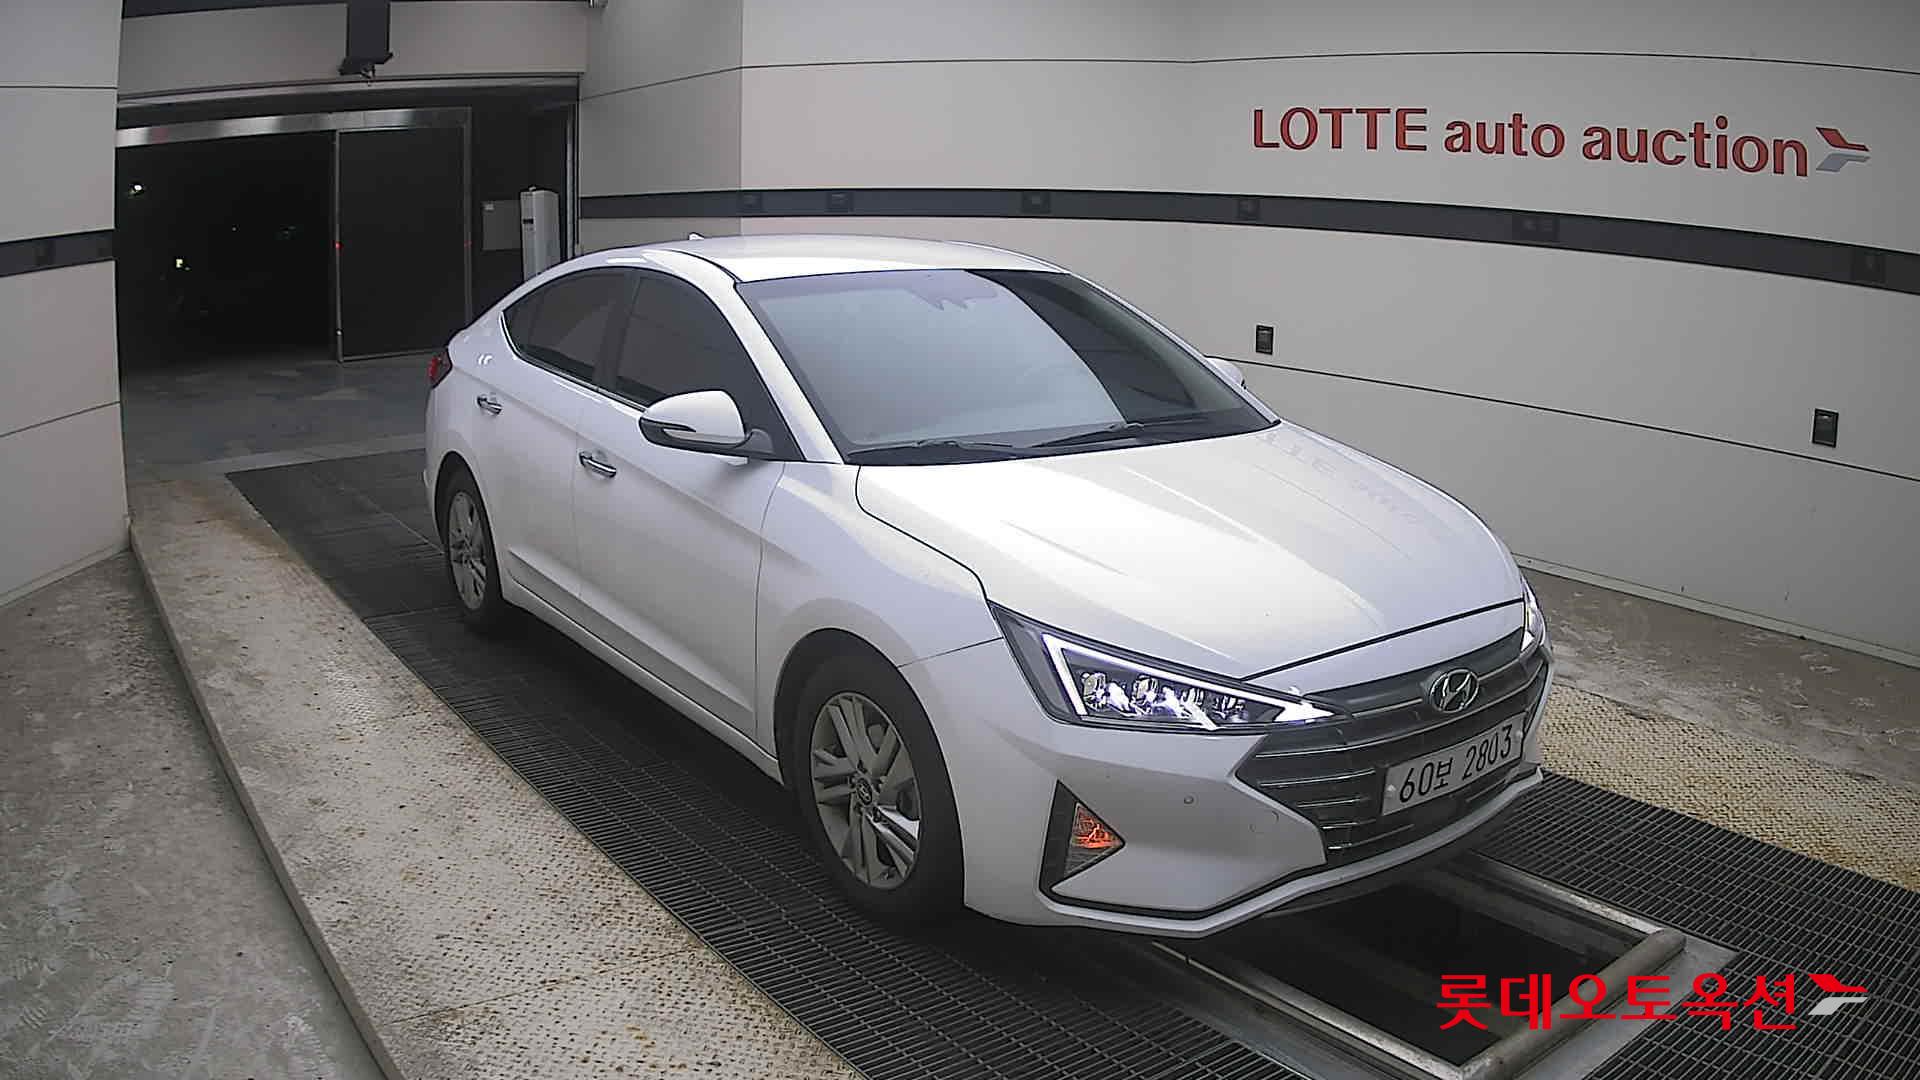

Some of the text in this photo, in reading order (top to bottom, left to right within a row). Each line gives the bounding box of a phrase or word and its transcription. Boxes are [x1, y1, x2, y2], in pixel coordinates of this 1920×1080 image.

[1252, 106, 1809, 178] LOTTE auto auction
[1399, 724, 1513, 803] 60보 2803
